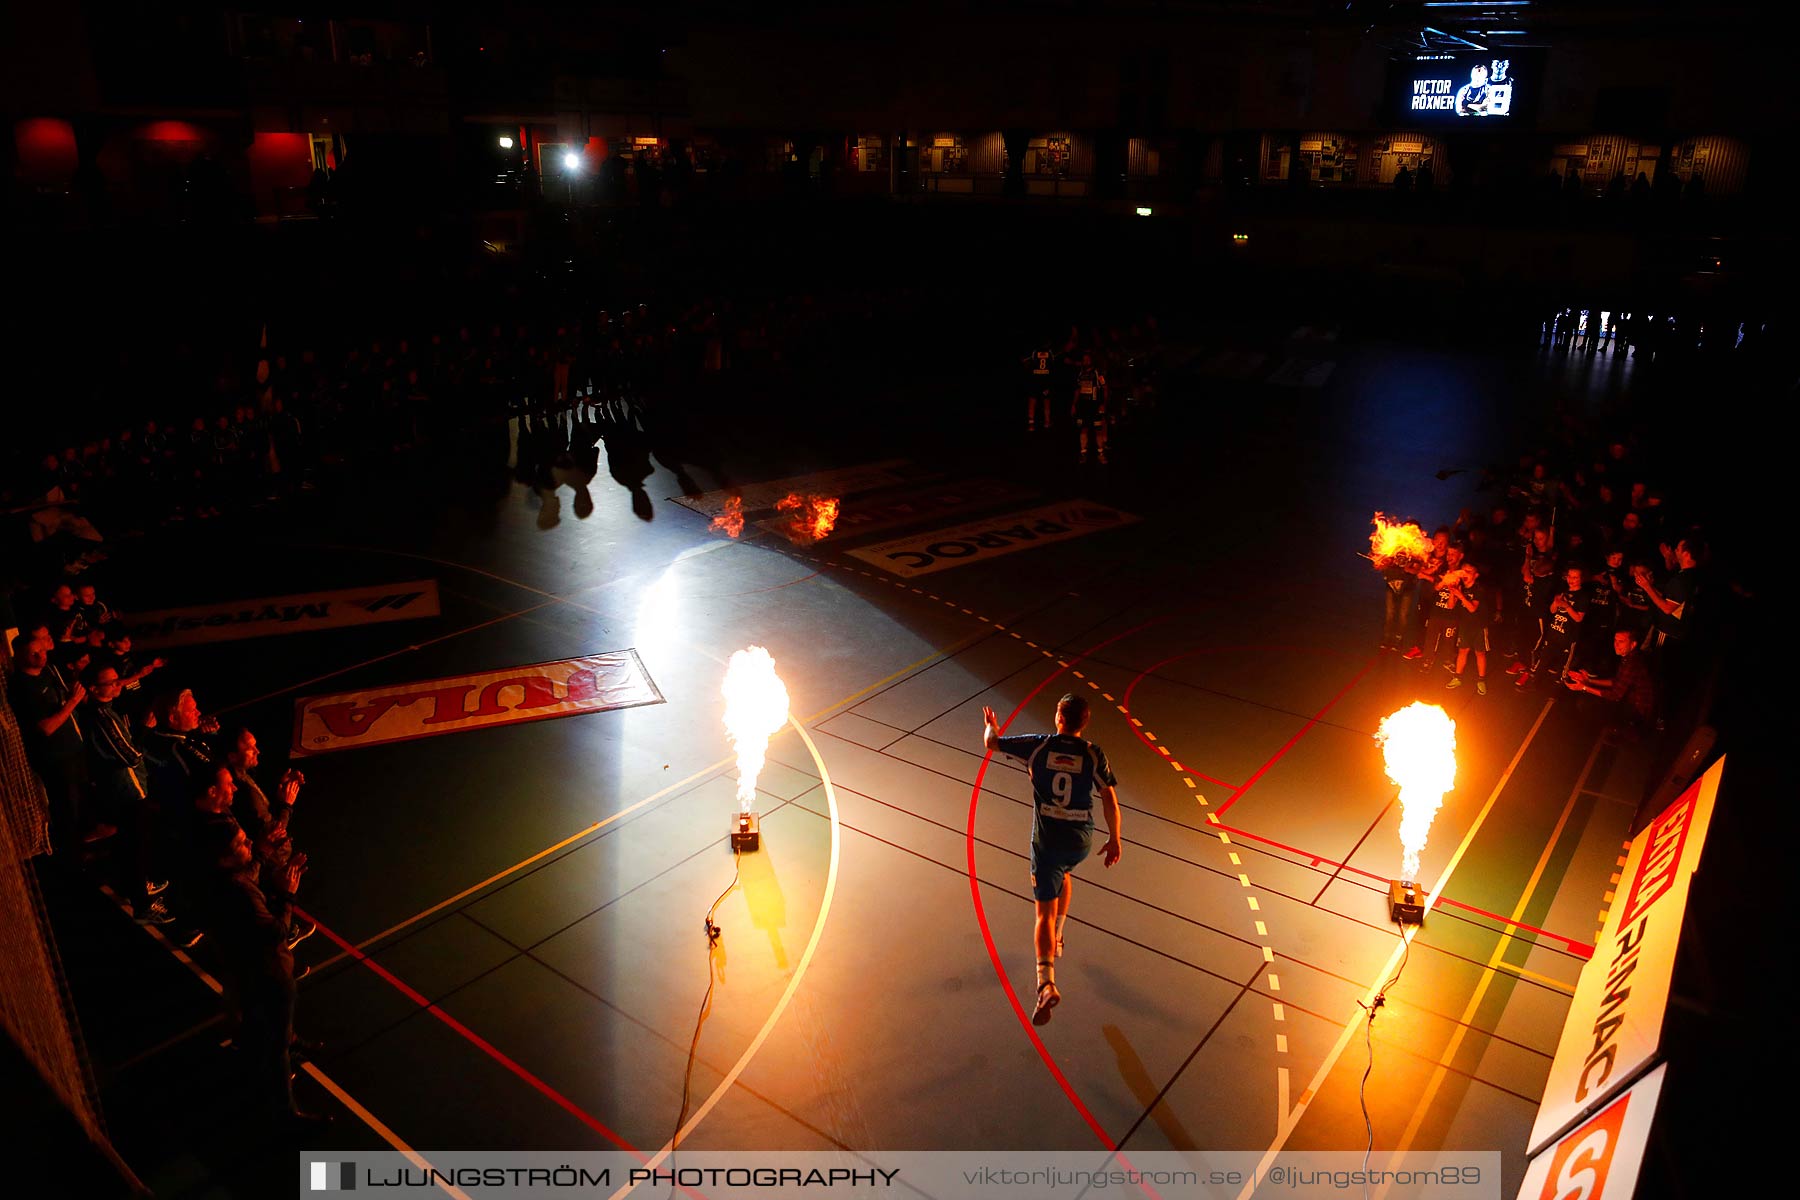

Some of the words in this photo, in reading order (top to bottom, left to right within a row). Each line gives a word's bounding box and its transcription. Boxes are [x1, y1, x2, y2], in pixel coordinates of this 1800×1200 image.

[1413, 80, 1451, 94] VICTOR
[1412, 94, 1455, 109] RÖXNER
[1039, 358, 1047, 370] 8
[886, 518, 1072, 568] PAROC
[308, 669, 600, 737] JULA
[1051, 771, 1073, 808] 9
